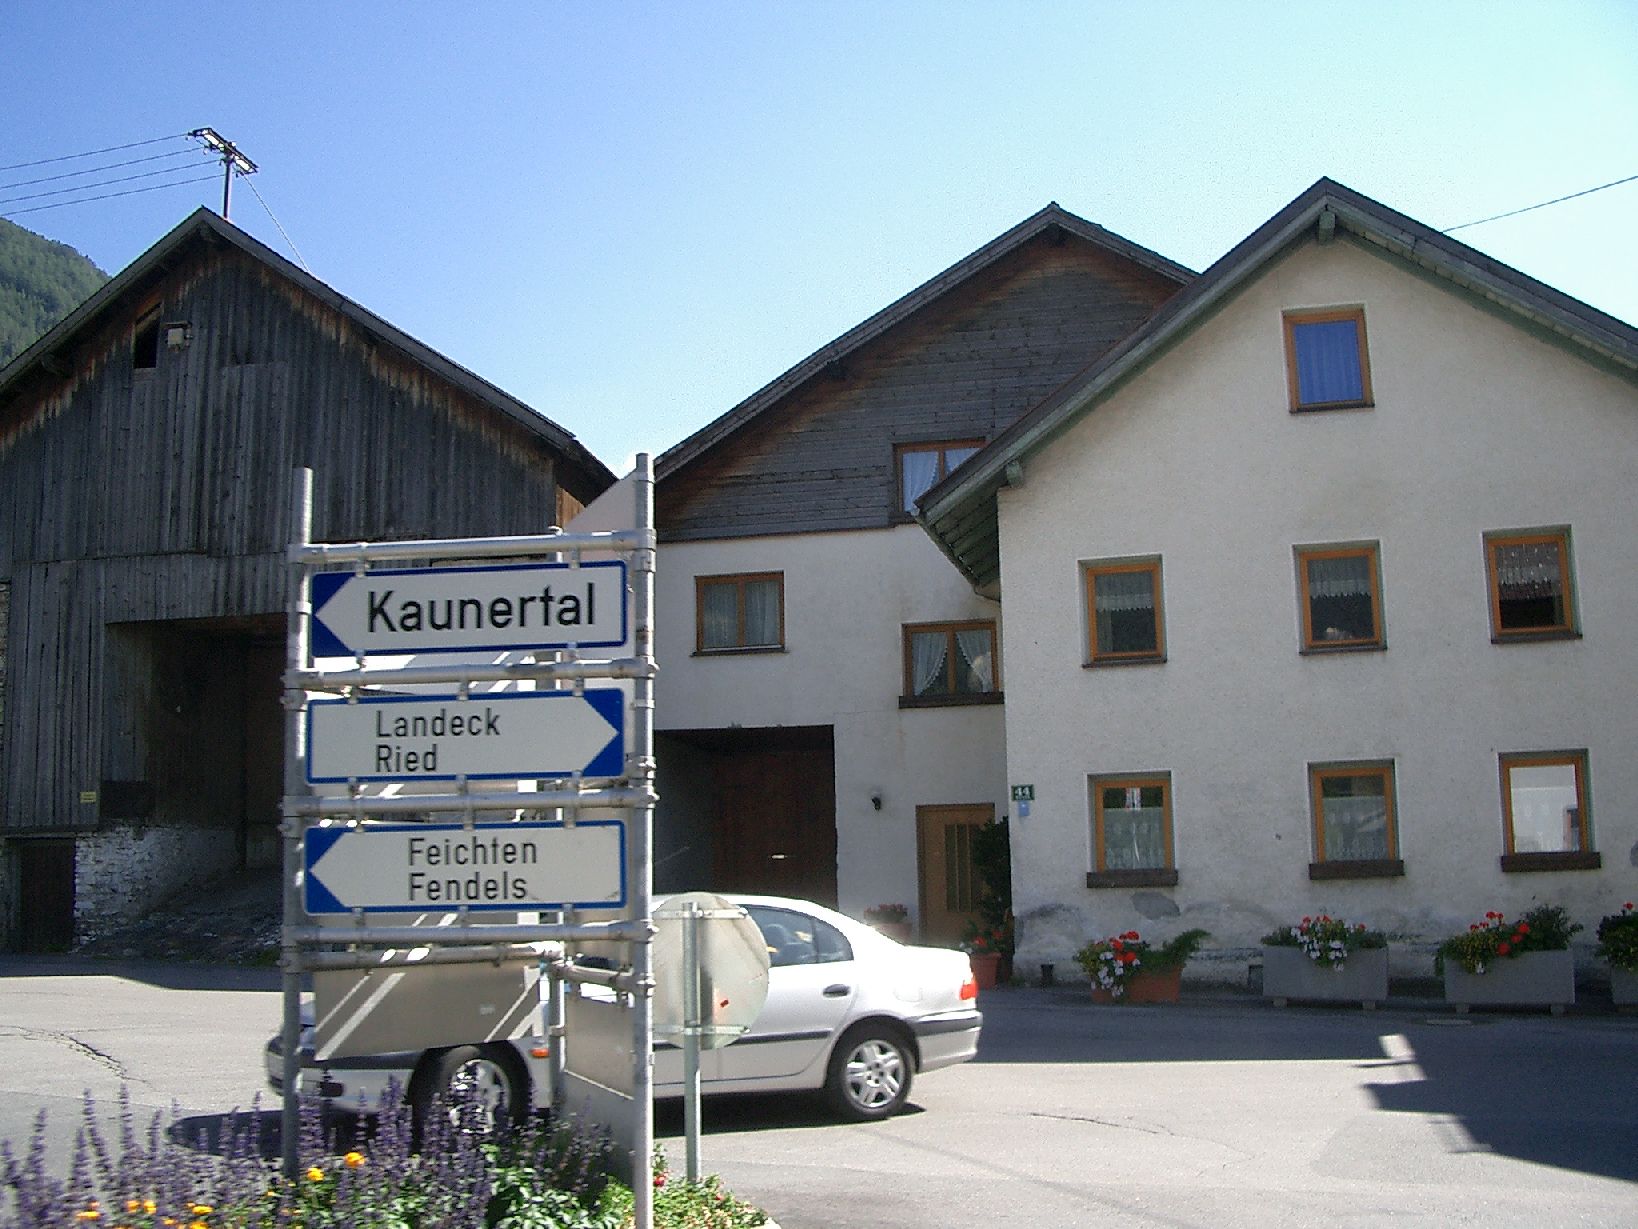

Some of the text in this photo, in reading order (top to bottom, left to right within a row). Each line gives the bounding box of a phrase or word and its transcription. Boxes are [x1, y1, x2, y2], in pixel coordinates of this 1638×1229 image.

[367, 582, 595, 633] Kaunertal
[376, 708, 500, 738] Landeck
[376, 744, 438, 773] Ried
[408, 837, 537, 867] Feichten
[409, 872, 527, 901] Fendels
